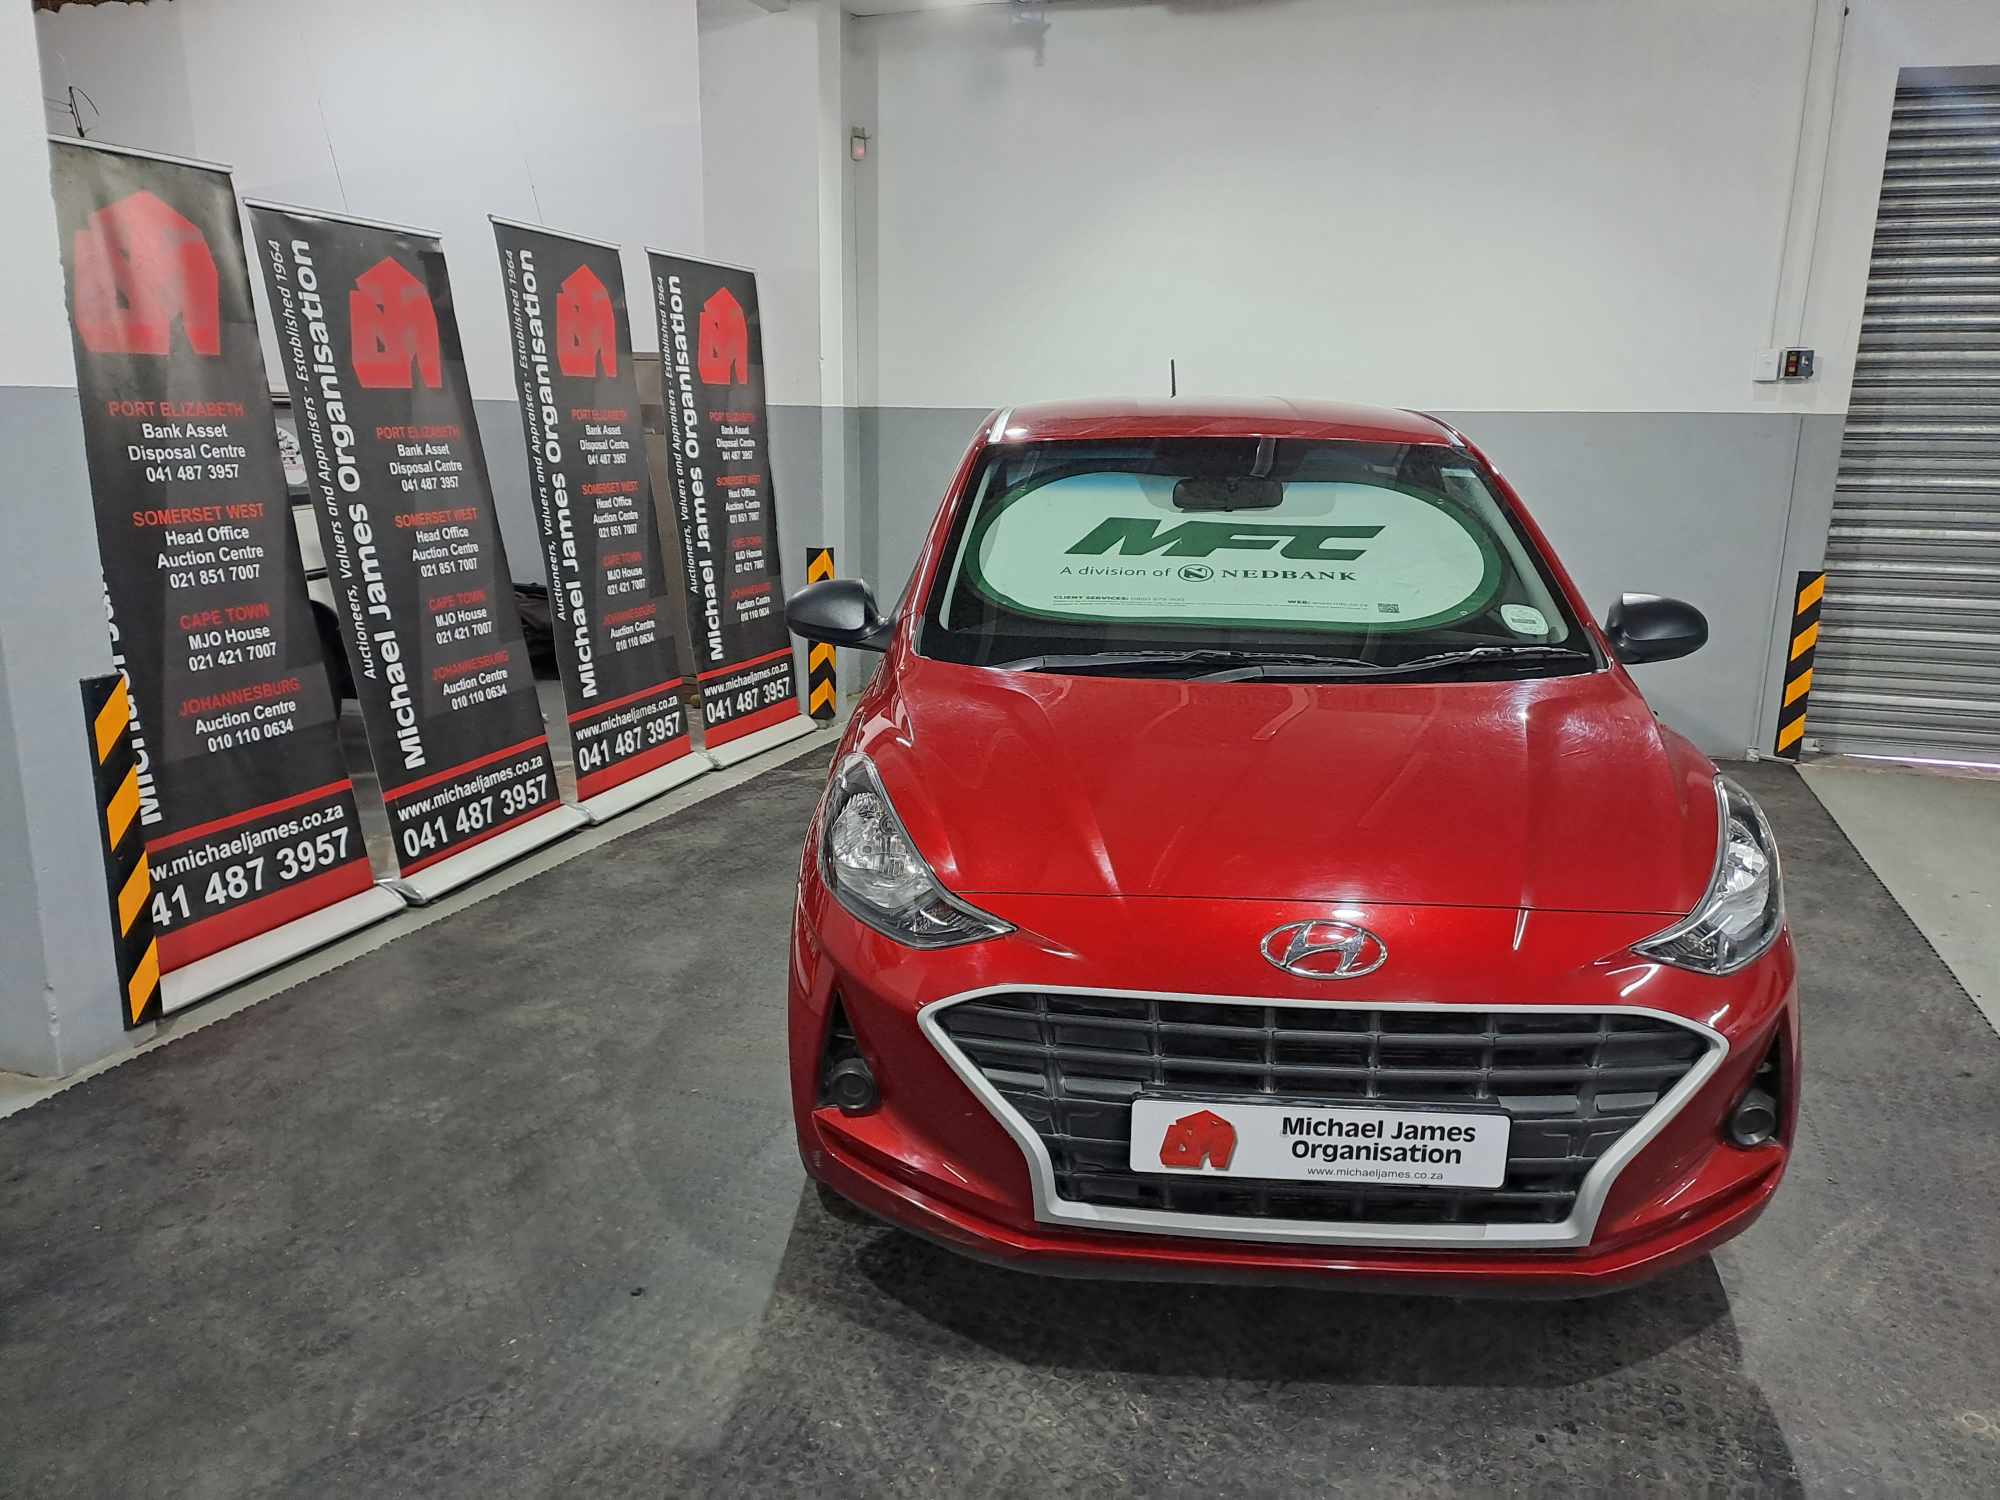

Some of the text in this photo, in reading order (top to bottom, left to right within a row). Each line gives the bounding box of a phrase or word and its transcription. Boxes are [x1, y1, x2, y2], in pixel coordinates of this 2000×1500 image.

[107, 400, 245, 417] PORT ELIZABETH
[668, 389, 681, 451] Appraisers
[142, 423, 228, 439] Bank Asset
[377, 426, 405, 440] PORT
[505, 248, 567, 620] Auctioneers, Valuers and Appraisers Established 1964
[585, 425, 601, 435] Bank
[128, 444, 246, 463] Disposal Centre
[397, 443, 450, 456] Bank Asset
[580, 439, 629, 451] Disposal Centre
[268, 240, 376, 679] Auctioneers, Valuers and Appraisers Established 1964
[390, 460, 462, 476] Disposal Centre
[669, 276, 724, 661] Michael James Organisation
[673, 453, 684, 475] and
[146, 464, 239, 482] 041 487 3957
[402, 476, 459, 492] 041 487 3957
[520, 249, 598, 698] Michael James Organisation
[290, 240, 426, 770] Michael James Organisation
[613, 496, 632, 507] Office
[678, 477, 689, 521] Valuers
[133, 503, 264, 527] SOMERSET WEST
[394, 508, 477, 528] SOMERSET WEST
[593, 510, 639, 524] Auction Centre
[165, 525, 249, 546] Head Office
[416, 527, 468, 543] Head Office
[1064, 517, 1386, 561] MFC
[157, 545, 264, 569] Auction Centre
[412, 542, 479, 562] Auction Centre
[682, 525, 698, 593] Auctioneers,
[170, 564, 260, 589] 021 851 7007
[421, 558, 477, 577] 021 851 7007
[622, 567, 642, 578] House
[1060, 566, 1171, 578] A division of
[1221, 569, 1357, 581] NEDBANK
[180, 603, 270, 629] CAPE TOWN
[435, 607, 487, 627] MJO House
[189, 626, 270, 650] MJO House
[436, 621, 492, 645] 021 421 7007
[610, 619, 655, 639] Auction Centre
[189, 642, 277, 671] 021 421 7007
[443, 668, 508, 696] Auction Centre
[704, 662, 788, 697] www.michaeljames.co.za
[180, 678, 302, 717] JOHANNESBURG
[451, 684, 507, 711] 010 110 0634
[706, 677, 790, 724] 041 487 3957
[196, 700, 296, 735] Auction Centre
[576, 695, 678, 741] www.michaeljames.co.za
[208, 719, 294, 753] 010 110 0634
[579, 711, 680, 772] 041 487 3957
[398, 754, 543, 821] www.michaeljames.co.za
[404, 774, 548, 857] 041 487 3957
[149, 805, 344, 882] w.michaeljames.co.za
[152, 828, 349, 927] 41 487 3957
[1282, 1117, 1476, 1143] Michael James
[1291, 1140, 1463, 1165] Organisation
[1307, 1167, 1443, 1180] www.michaeljames.co.za
